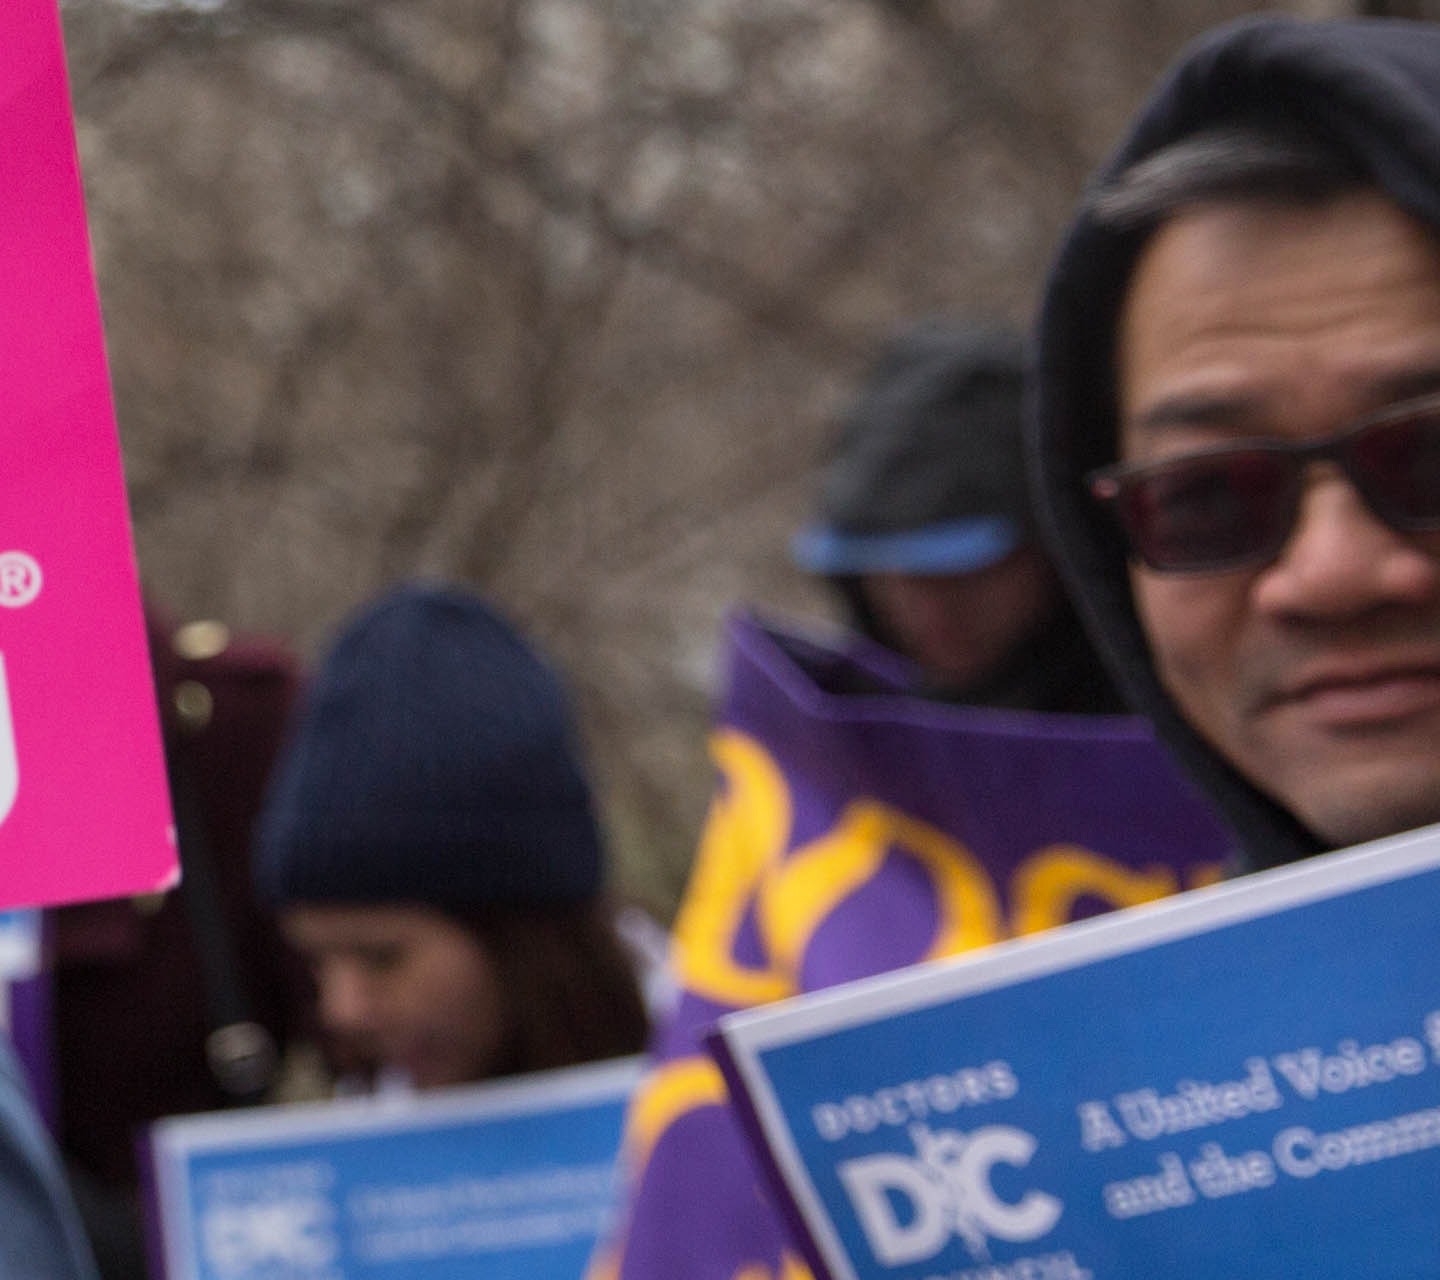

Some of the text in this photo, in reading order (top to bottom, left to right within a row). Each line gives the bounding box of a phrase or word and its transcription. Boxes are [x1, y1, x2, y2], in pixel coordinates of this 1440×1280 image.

[812, 1060, 1019, 1141] DOCTORS
[1077, 1100, 1127, 1151] A
[1114, 1056, 1282, 1140] United
[1274, 1037, 1426, 1101] Voice
[1102, 1152, 1195, 1219] and
[1188, 1141, 1276, 1198] the
